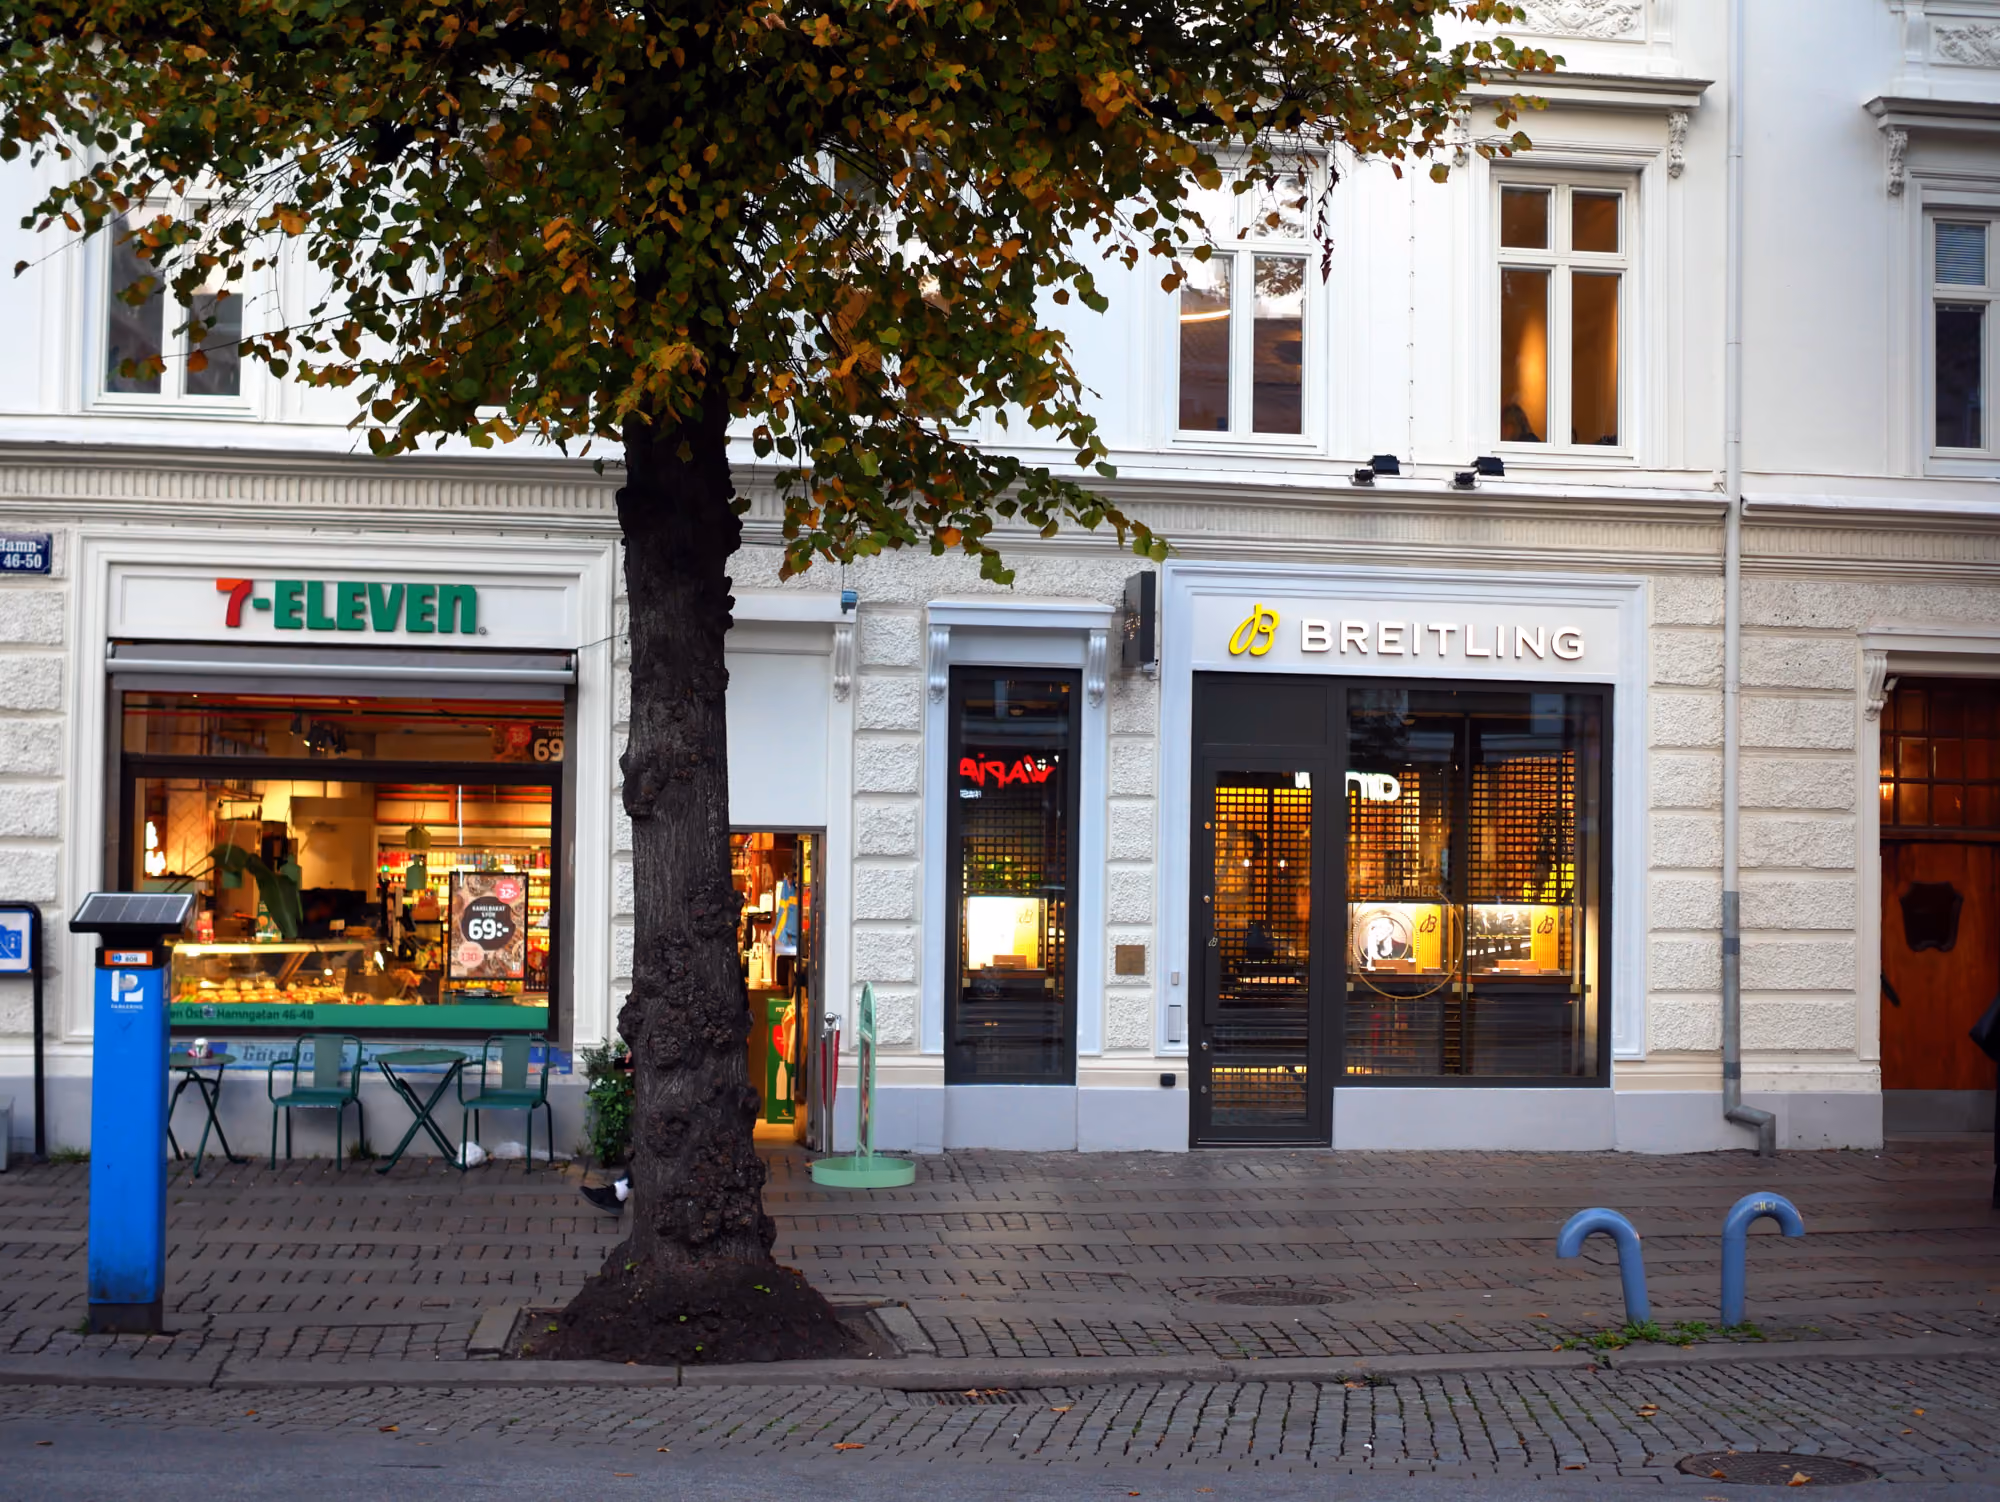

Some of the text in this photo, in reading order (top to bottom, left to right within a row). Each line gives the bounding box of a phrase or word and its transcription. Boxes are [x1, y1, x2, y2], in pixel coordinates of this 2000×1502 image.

[3, 553, 42, 568] 46-50
[1300, 618, 1585, 661] BREITLING
[469, 918, 509, 940] 69:-
